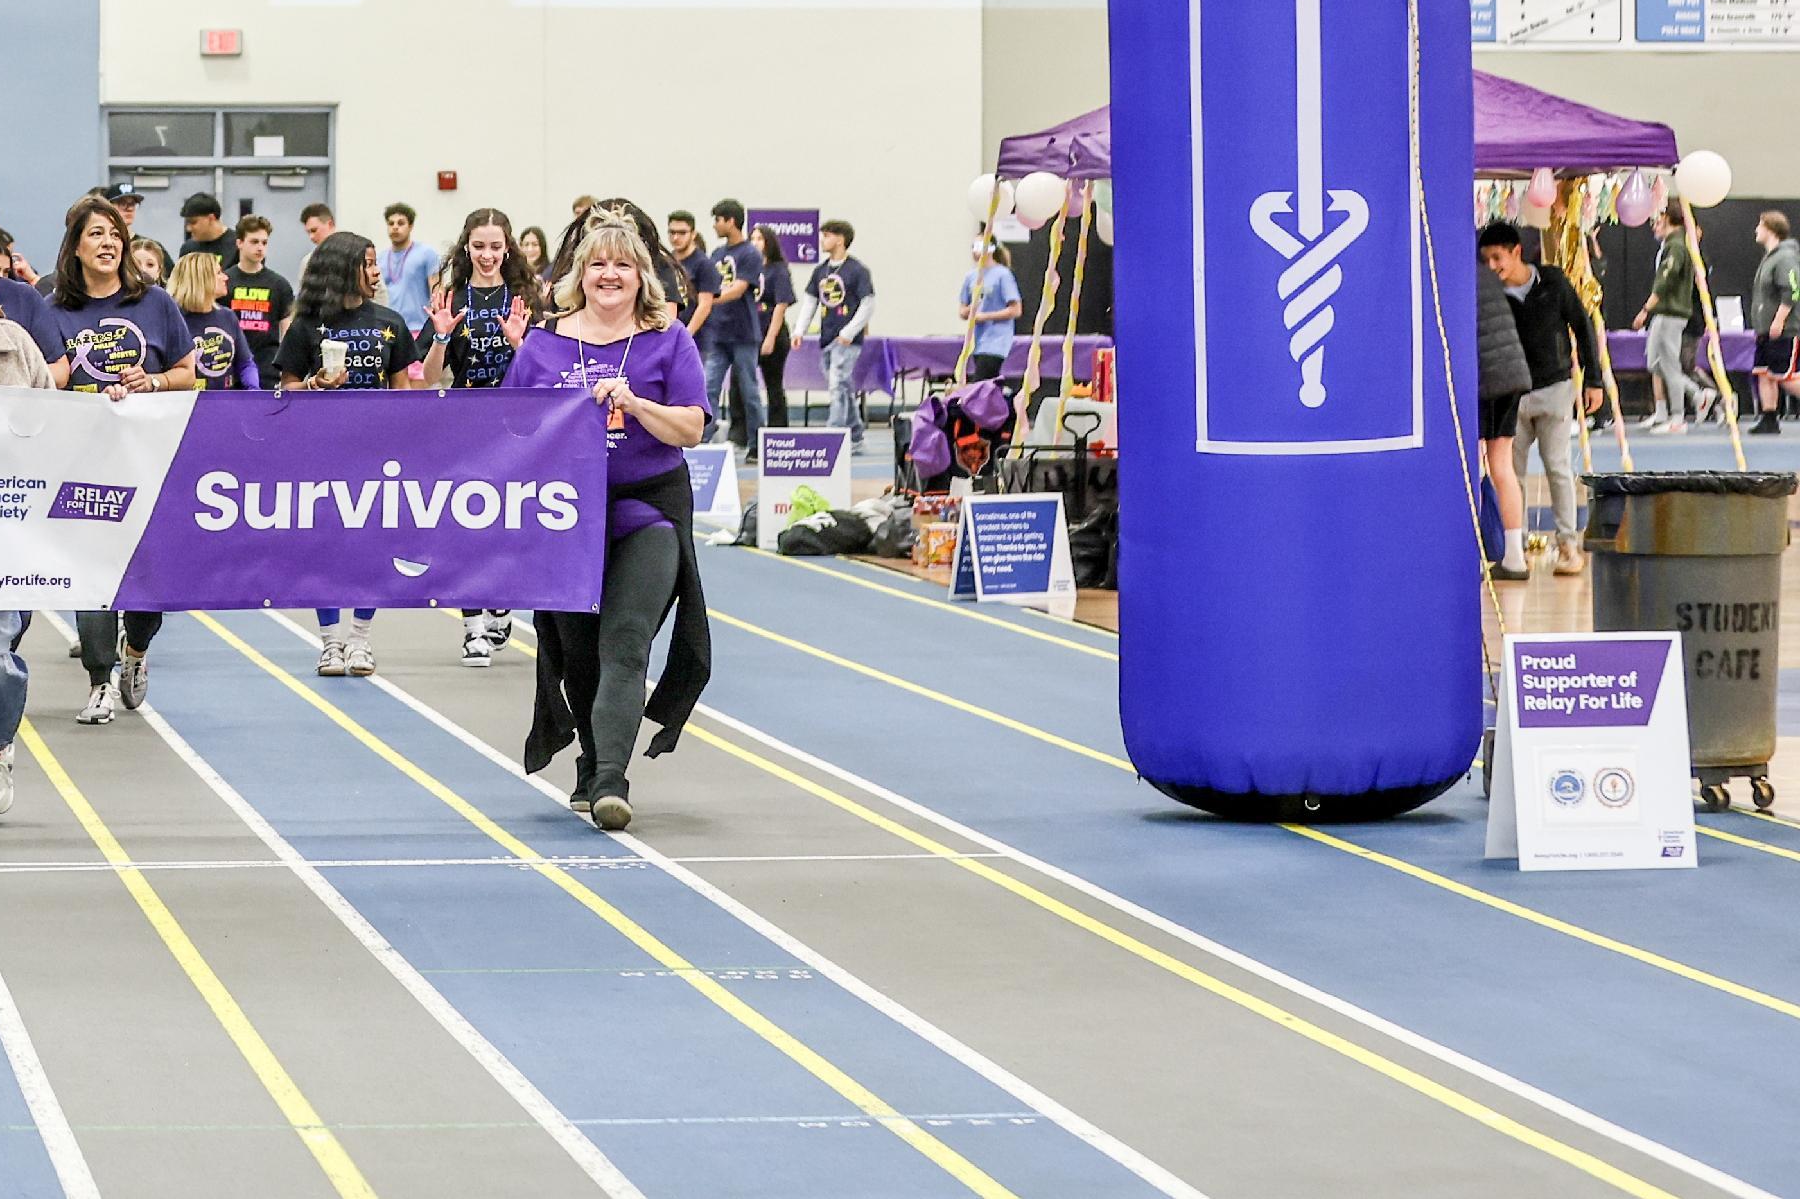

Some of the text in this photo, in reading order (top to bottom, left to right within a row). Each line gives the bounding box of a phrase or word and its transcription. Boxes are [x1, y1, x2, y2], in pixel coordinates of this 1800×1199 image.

[233, 287, 270, 300] GLOW
[240, 310, 263, 320] THAN
[240, 320, 271, 331] ANCER
[66, 332, 113, 349] LAZERS
[327, 328, 382, 340] Leave
[347, 340, 371, 351] no
[344, 355, 383, 368] pace
[766, 437, 796, 448] Proud
[766, 448, 827, 459] Supporter of
[766, 458, 829, 471] Relay For Life
[74, 486, 128, 505] RELAY
[194, 460, 580, 532] Survivors
[66, 500, 121, 518] FOR LIFE
[982, 565, 996, 575] they
[1675, 601, 1778, 633] STUDENT
[1520, 653, 1577, 670] Proud
[1696, 647, 1761, 681] CAFE
[1522, 670, 1638, 693] Supporter of
[1523, 691, 1644, 715] Relay For Life
